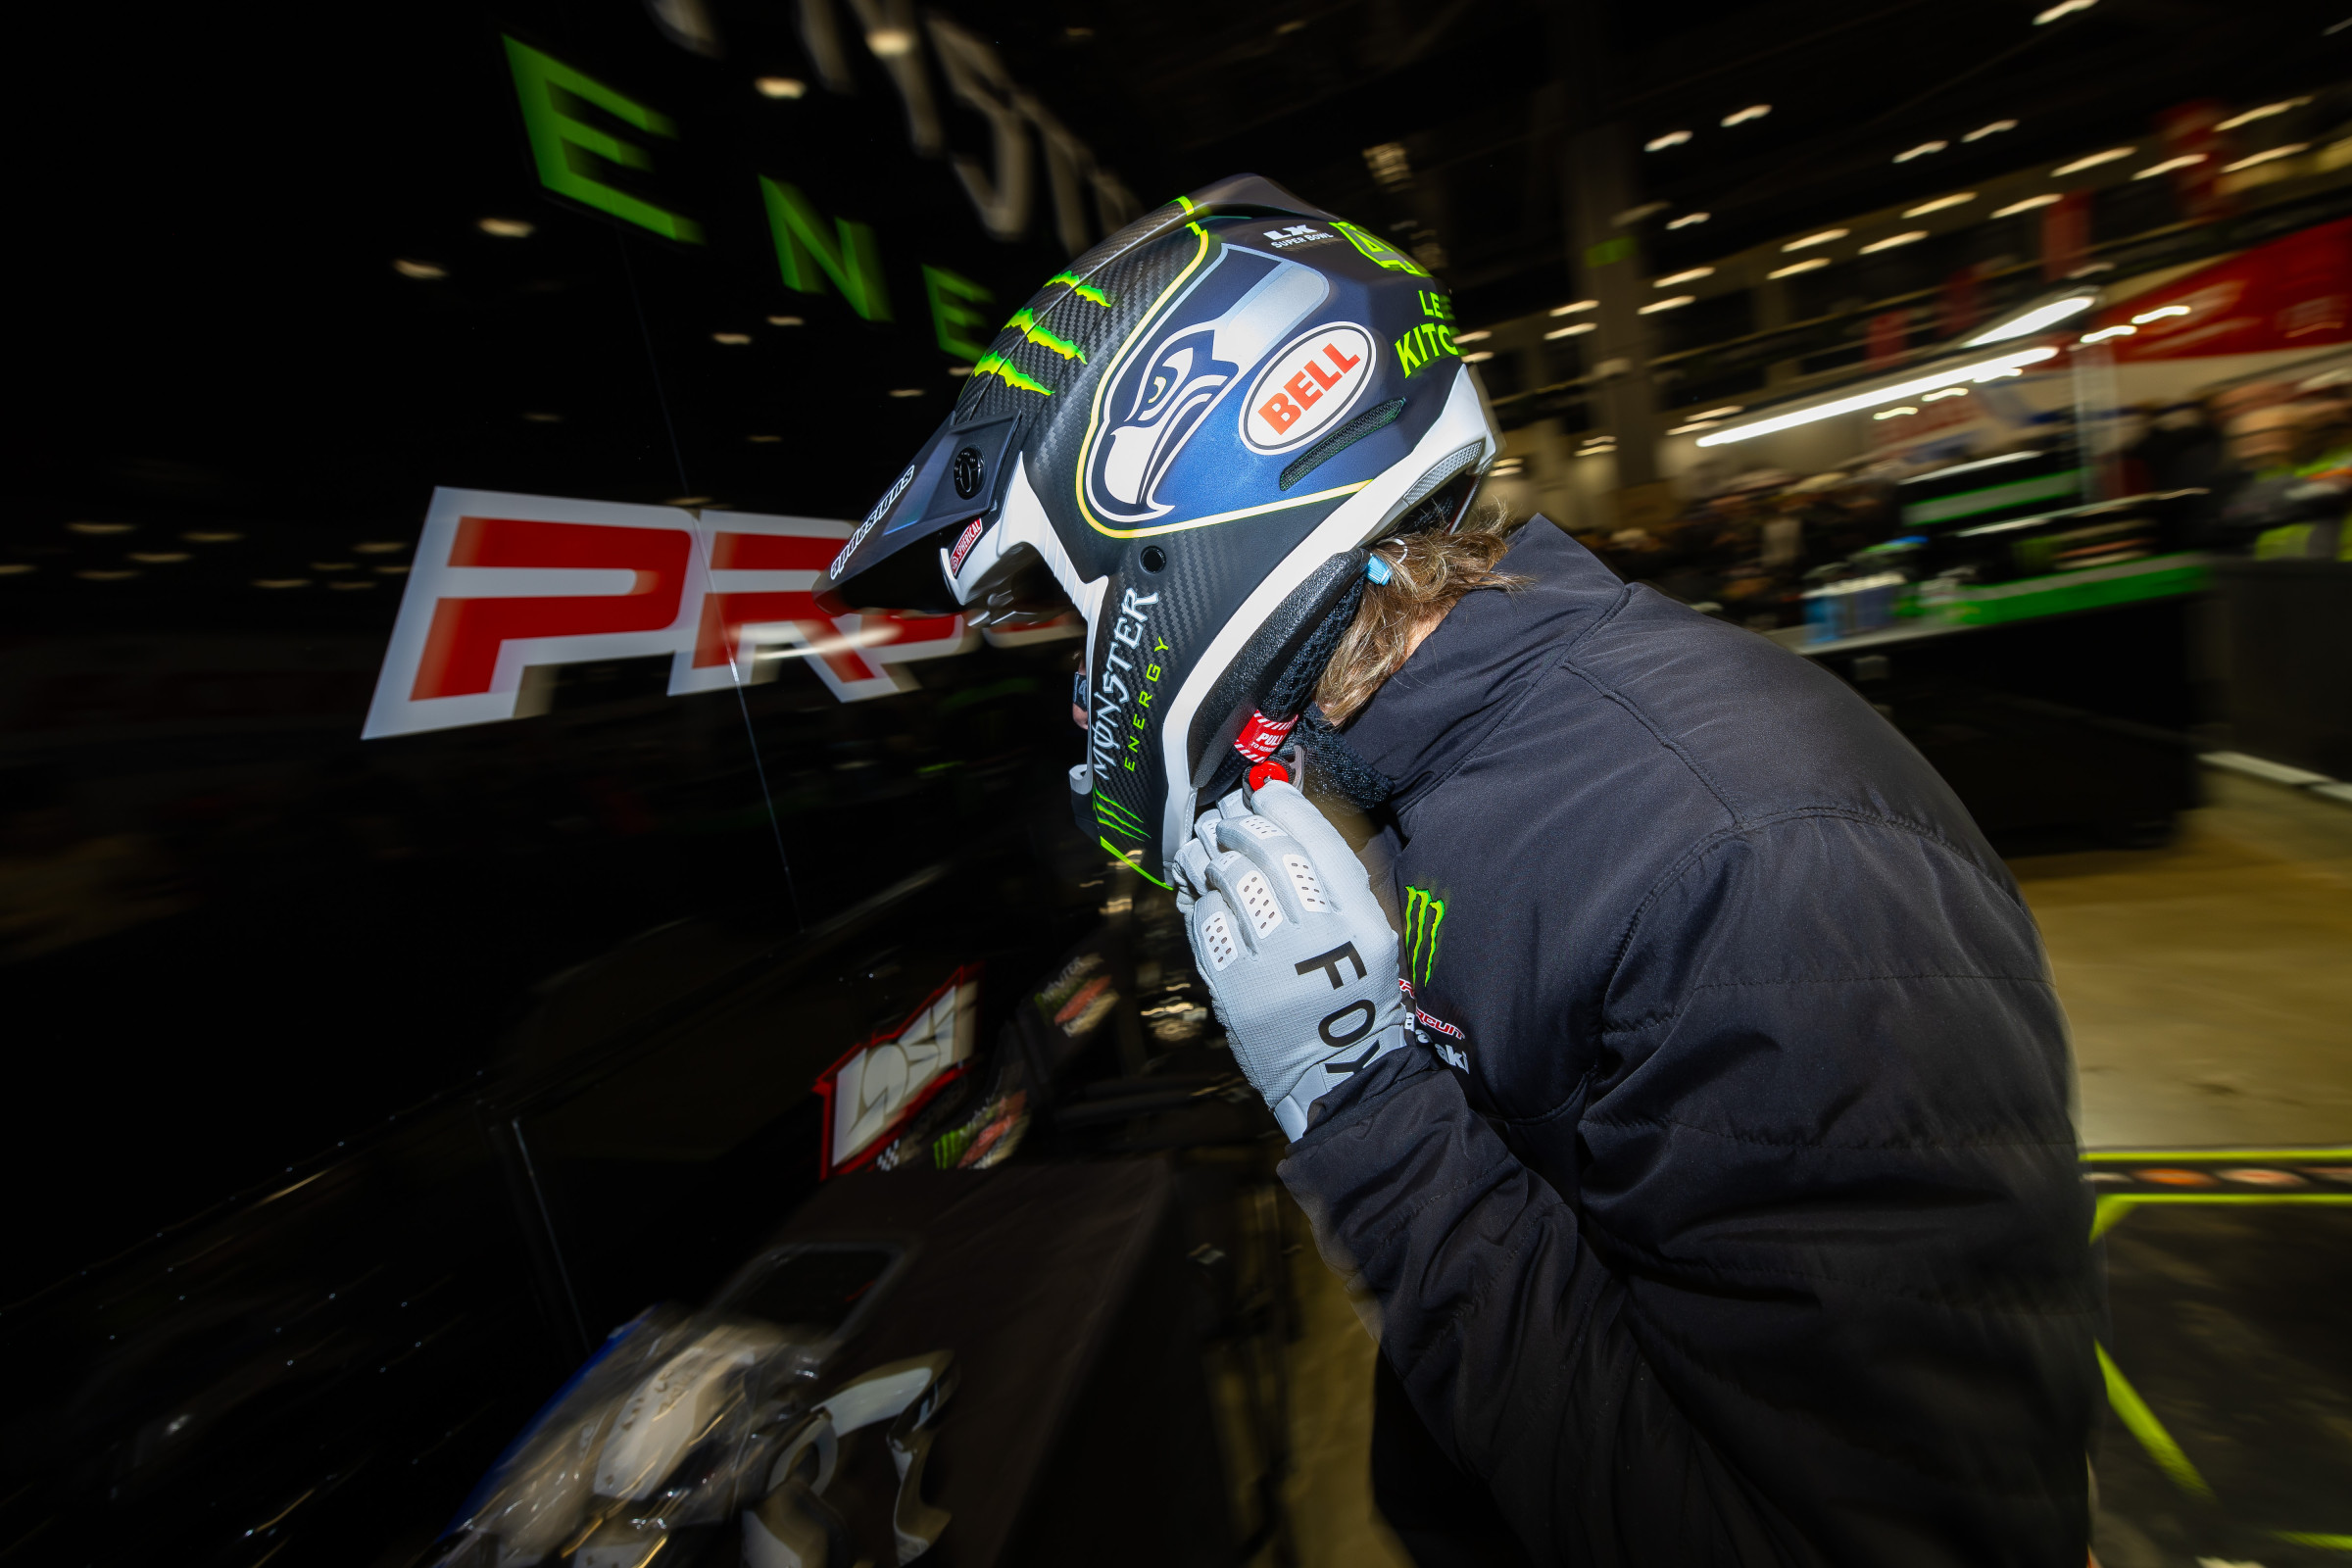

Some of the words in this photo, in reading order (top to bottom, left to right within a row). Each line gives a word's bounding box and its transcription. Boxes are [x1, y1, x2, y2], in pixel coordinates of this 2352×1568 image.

[1263, 224, 1317, 241] LX
[1271, 236, 1307, 249] SUPER
[1258, 343, 1360, 436] BELL
[363, 485, 965, 740] PR
[1092, 588, 1159, 781] MONSTER
[1124, 636, 1169, 772] ENERGY
